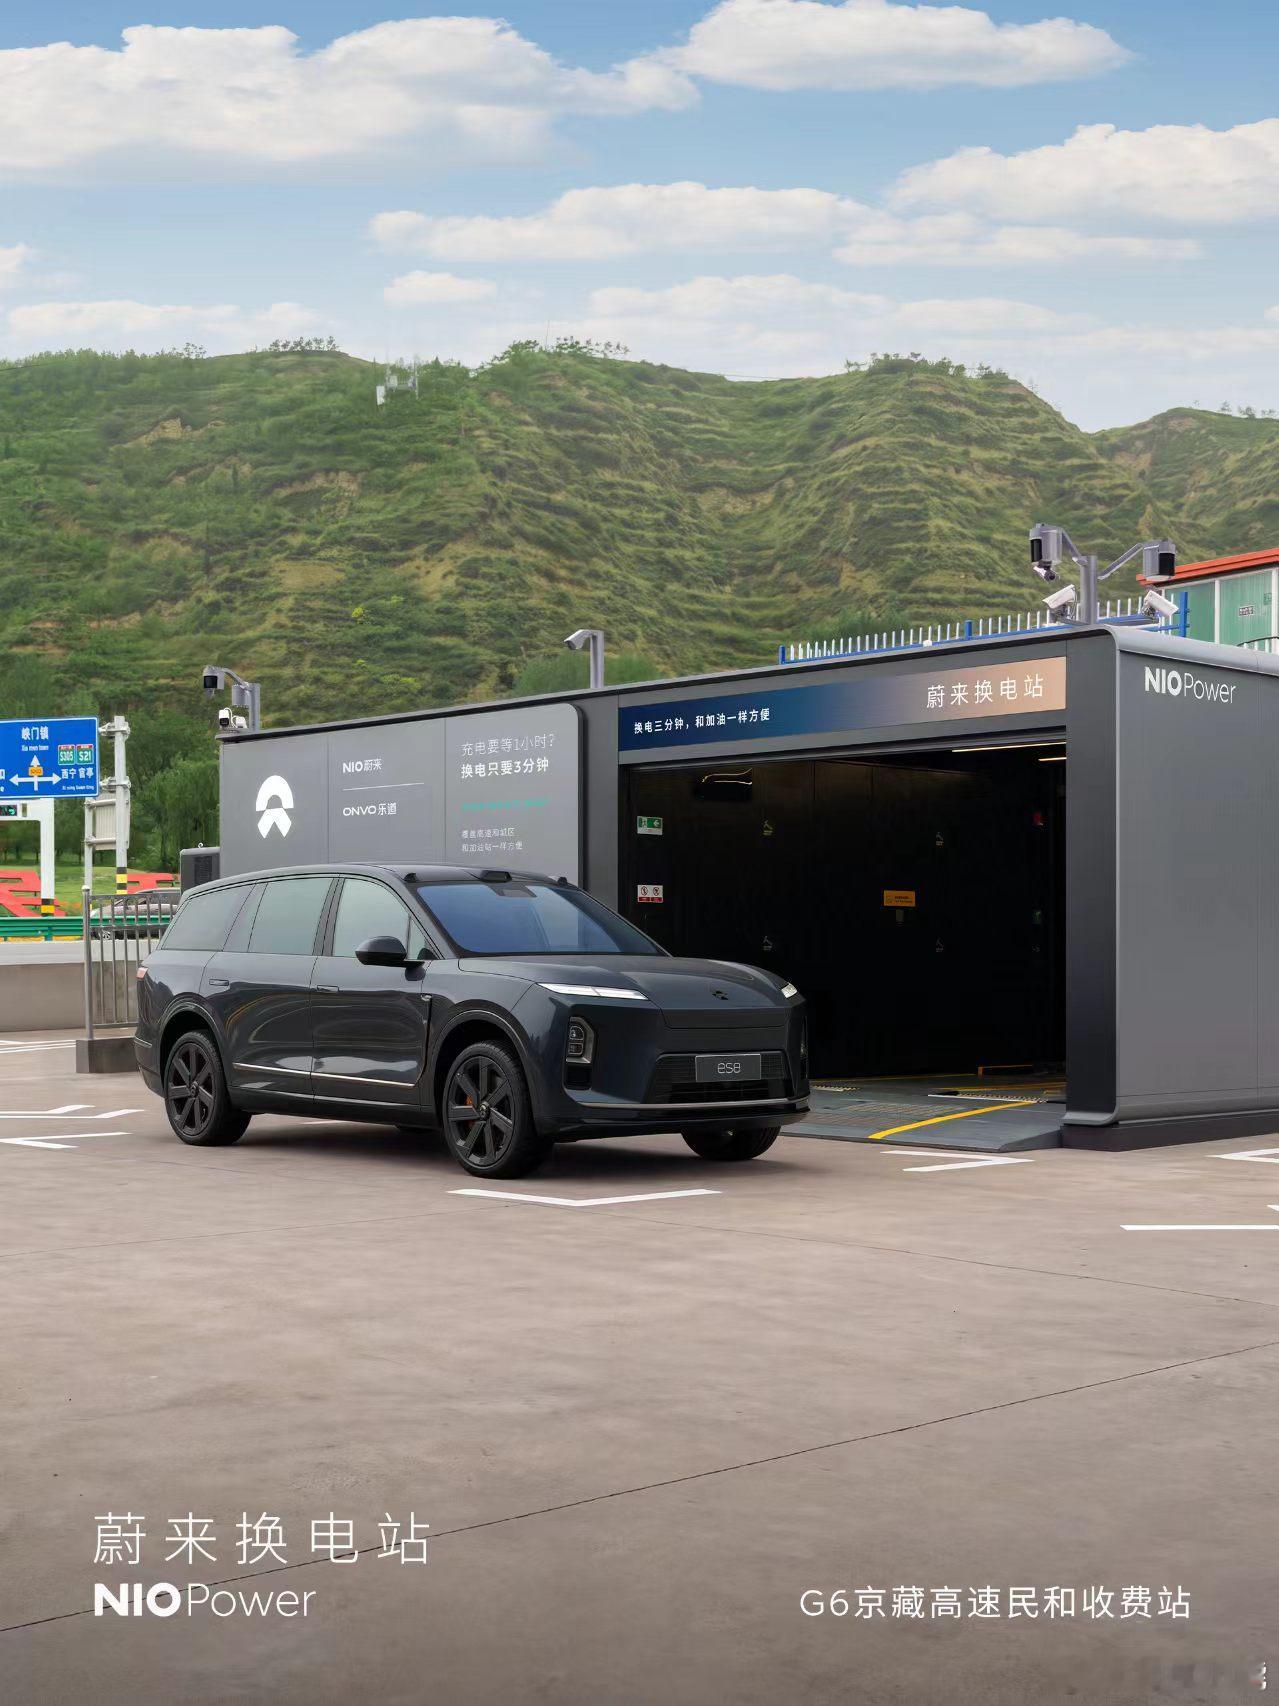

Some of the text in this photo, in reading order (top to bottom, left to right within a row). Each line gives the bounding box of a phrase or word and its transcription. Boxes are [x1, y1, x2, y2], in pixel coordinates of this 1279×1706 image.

[926, 673, 1045, 710] 蔚来换电站
[78, 751, 92, 762] S21
[460, 756, 549, 779] 换电只要3分钟
